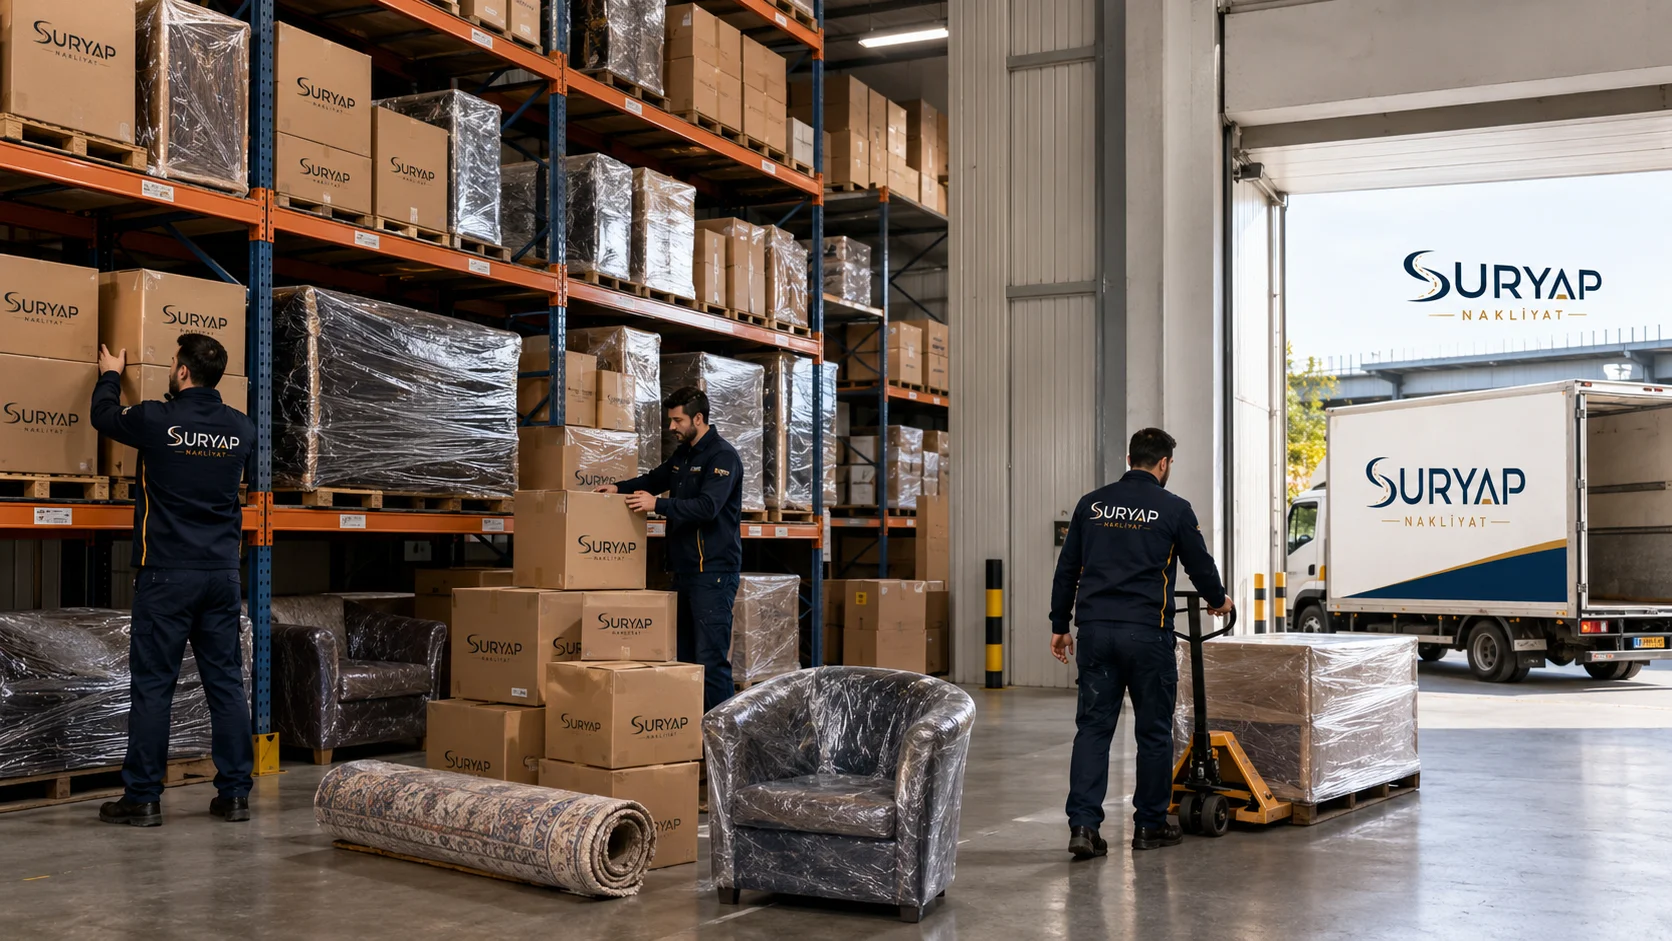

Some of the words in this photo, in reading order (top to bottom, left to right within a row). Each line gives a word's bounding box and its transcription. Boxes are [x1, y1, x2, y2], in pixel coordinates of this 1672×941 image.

[33, 20, 116, 60] SURYAP
[297, 77, 356, 109] SURYAP
[300, 157, 350, 183] SURYAP
[390, 156, 435, 181] SURYAP
[4, 291, 79, 319] SURYAP
[162, 304, 228, 330] SURYAP
[3, 402, 79, 426] SURYAP
[167, 425, 240, 450] SURYAP
[1366, 456, 1526, 508] SURYAP
[1090, 501, 1159, 523] SURYAP
[1404, 514, 1487, 528] NAKLİYAT
[578, 534, 637, 554] SURYAP
[597, 612, 653, 630] SURYAP
[466, 634, 523, 656] SURYAP
[560, 712, 602, 732] SURYAP
[631, 715, 688, 735] SURYAP
[444, 750, 491, 773] SURYAP
